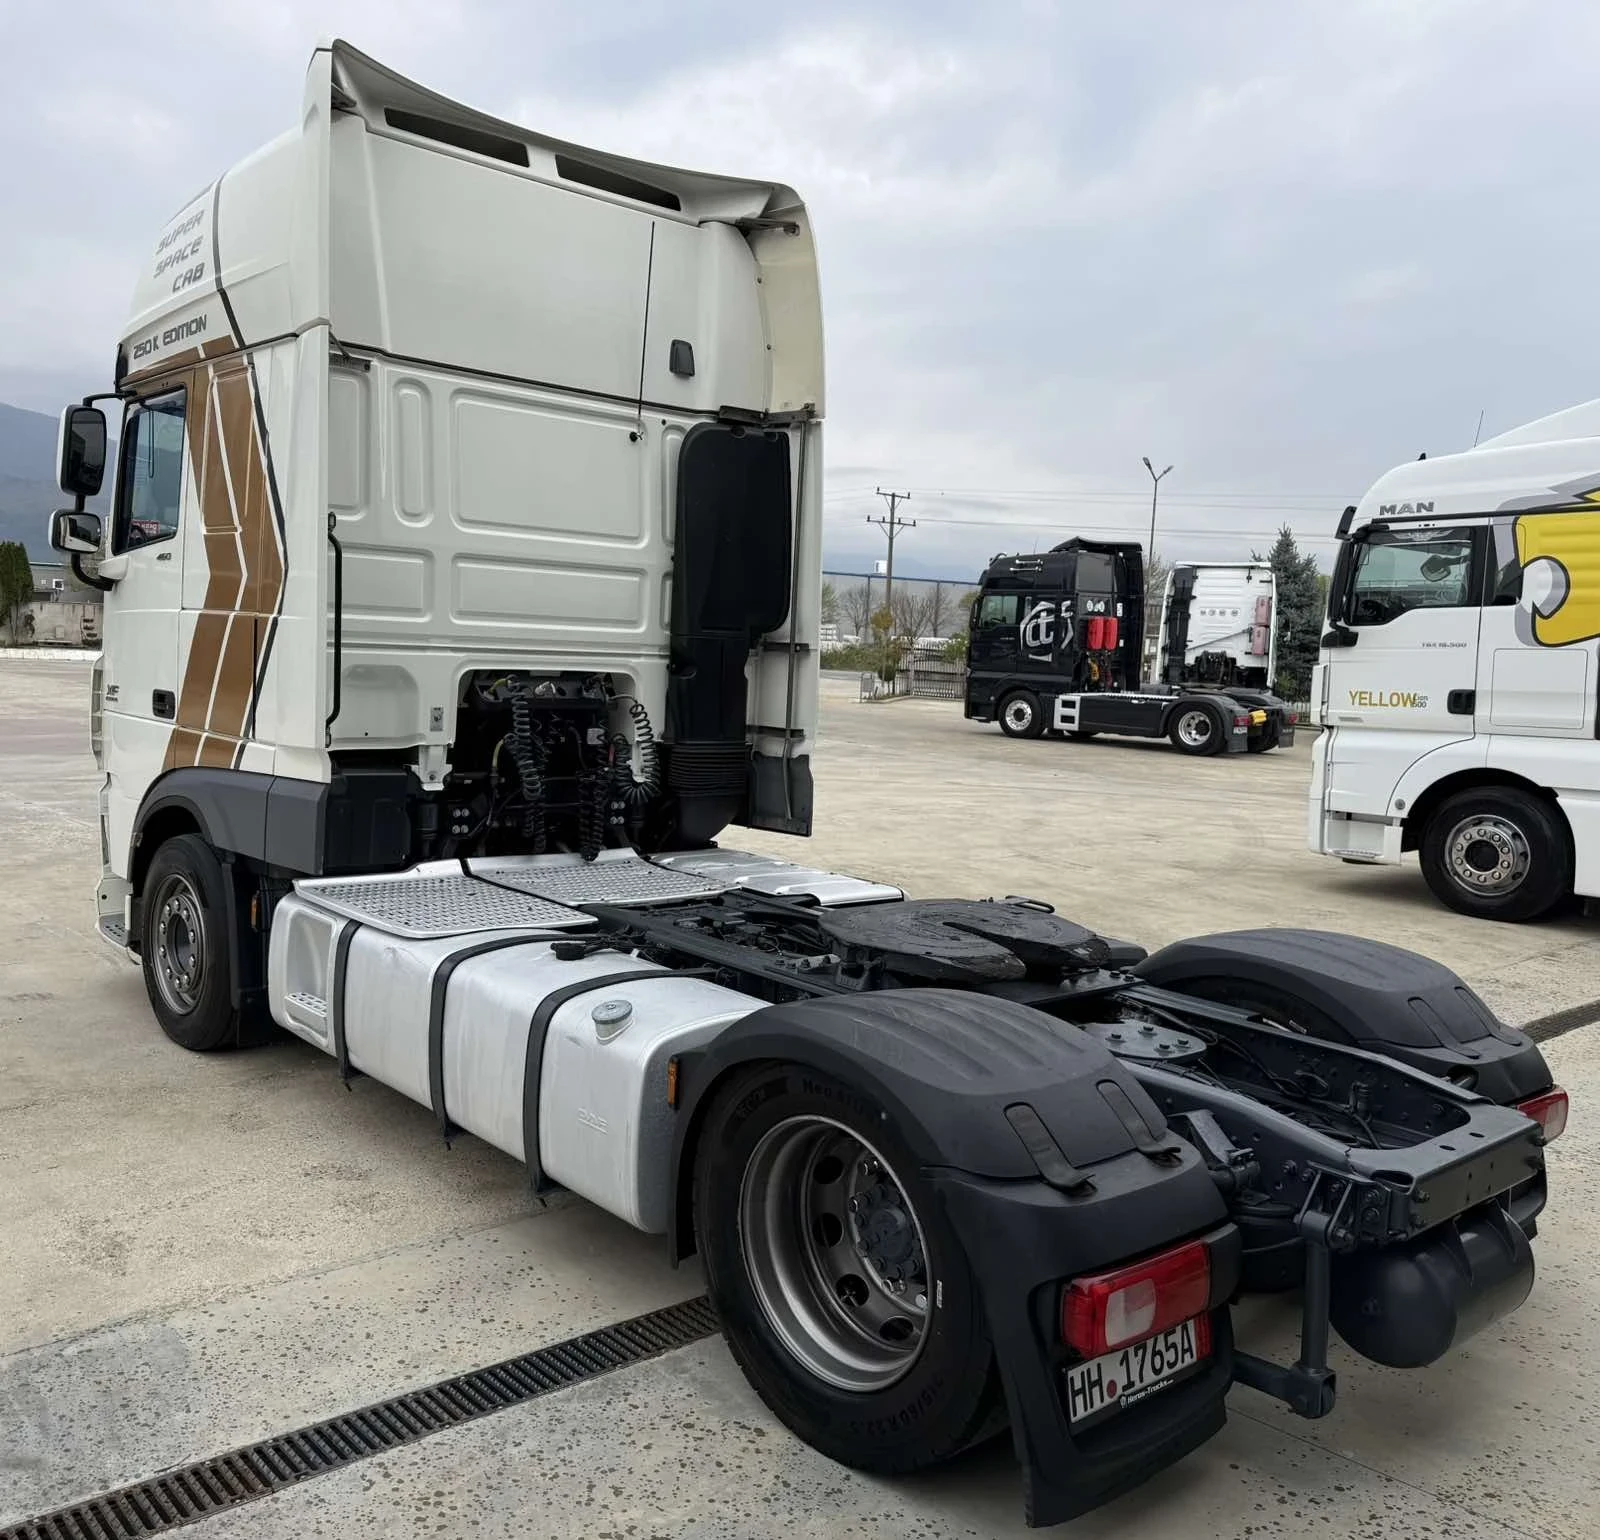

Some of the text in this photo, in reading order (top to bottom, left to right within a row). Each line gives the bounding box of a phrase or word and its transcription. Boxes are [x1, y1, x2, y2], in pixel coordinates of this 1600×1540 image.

[156, 209, 205, 255] SUPER
[153, 235, 204, 279] SPACE
[172, 262, 205, 293] CAB
[162, 314, 207, 346] EDITION
[1379, 502, 1434, 515] MAN
[1348, 691, 1417, 708] YELLOW
[1069, 1321, 1195, 1418] HH 1765A
